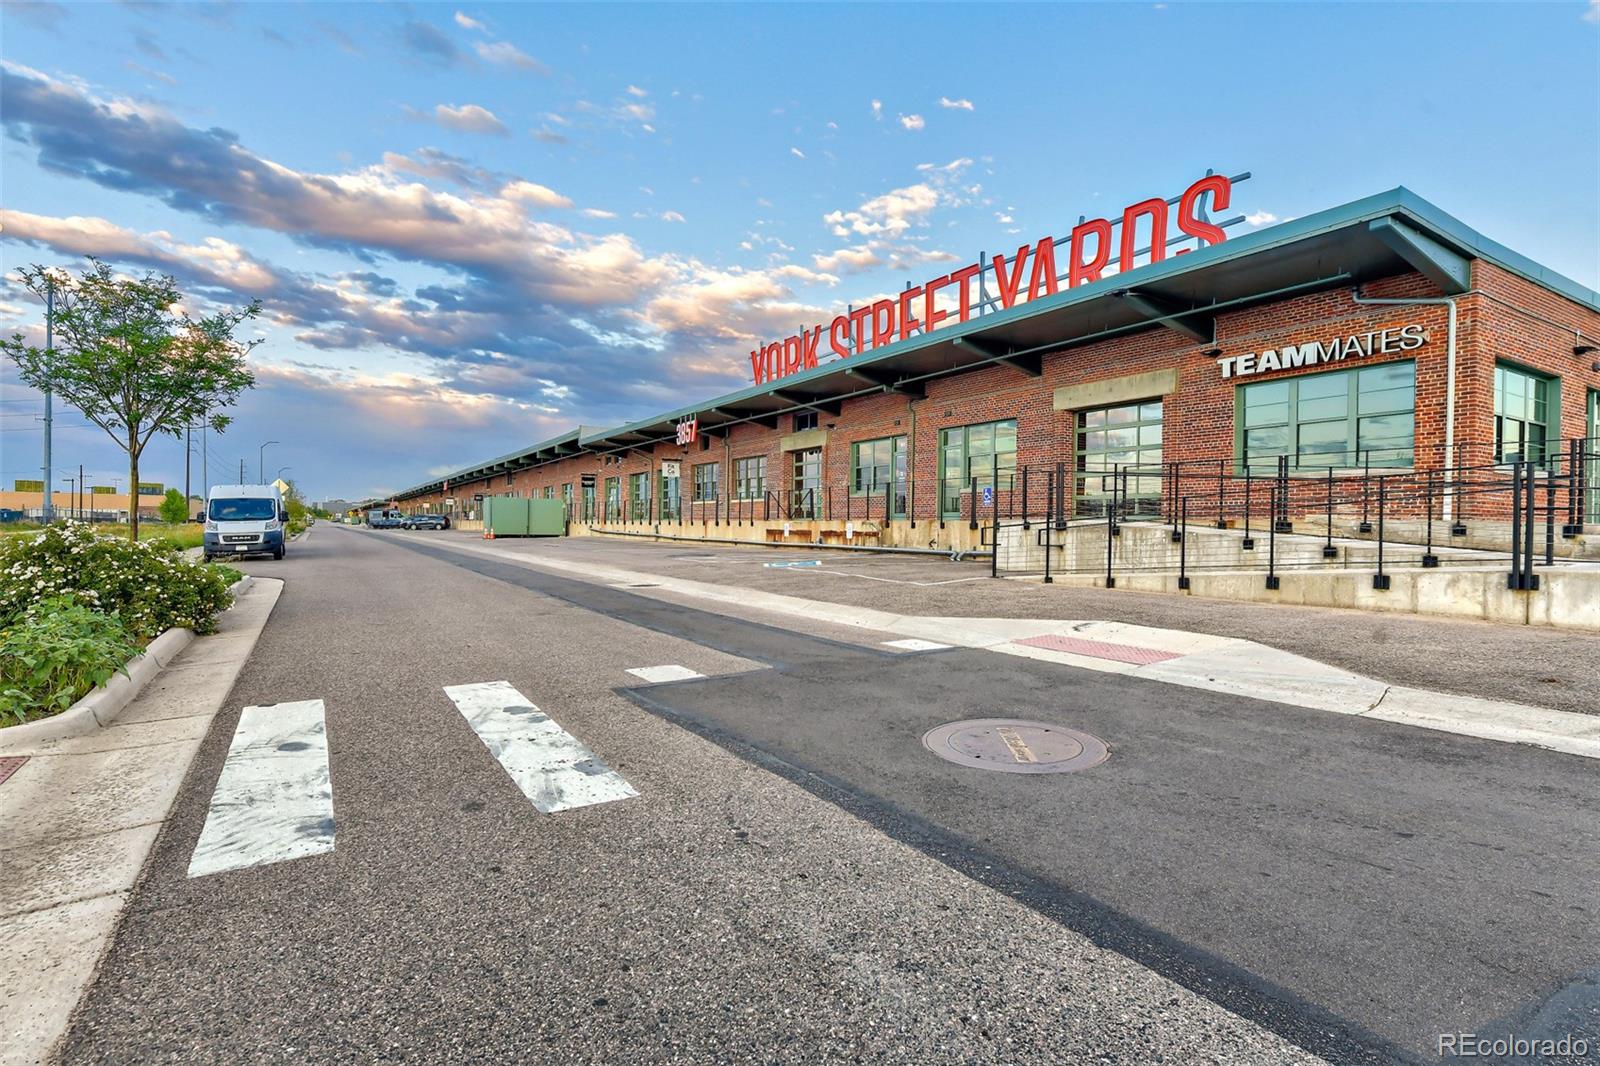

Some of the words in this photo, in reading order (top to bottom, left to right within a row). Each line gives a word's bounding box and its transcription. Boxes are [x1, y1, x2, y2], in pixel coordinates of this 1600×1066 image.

[750, 324, 822, 386] YORK
[830, 263, 980, 363] STREET
[992, 174, 1232, 310] YARDS
[1217, 324, 1424, 378] TEAMMATES
[676, 419, 697, 446] 3857
